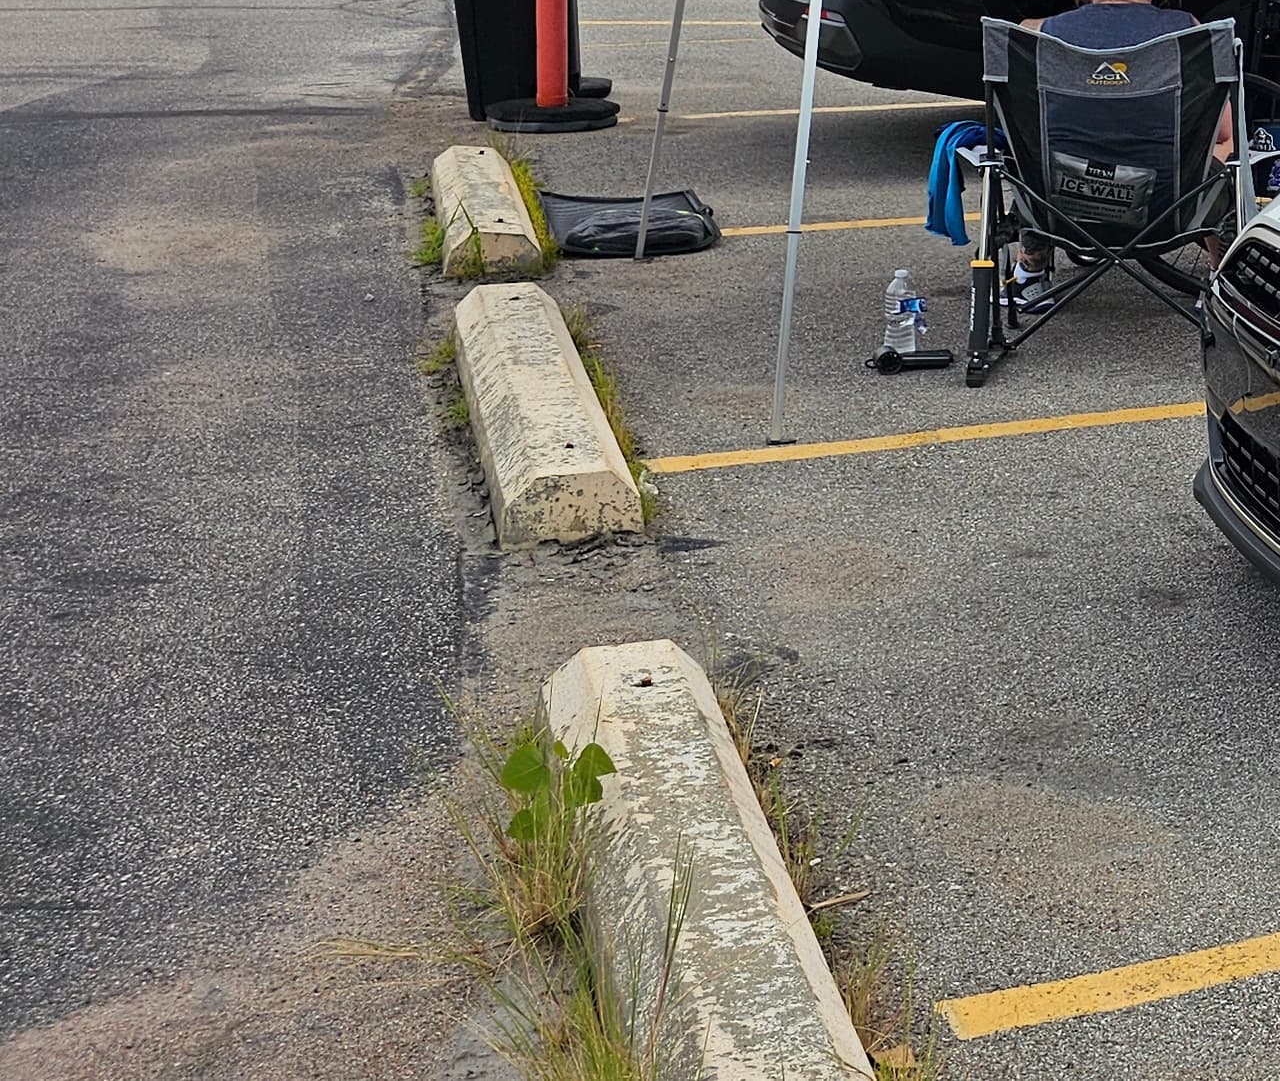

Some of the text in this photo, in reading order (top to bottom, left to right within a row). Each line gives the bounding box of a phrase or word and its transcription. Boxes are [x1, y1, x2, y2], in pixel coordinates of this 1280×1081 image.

[1088, 167, 1114, 177] TITAN
[1061, 177, 1086, 193] ICE
[1090, 184, 1134, 201] WALL
